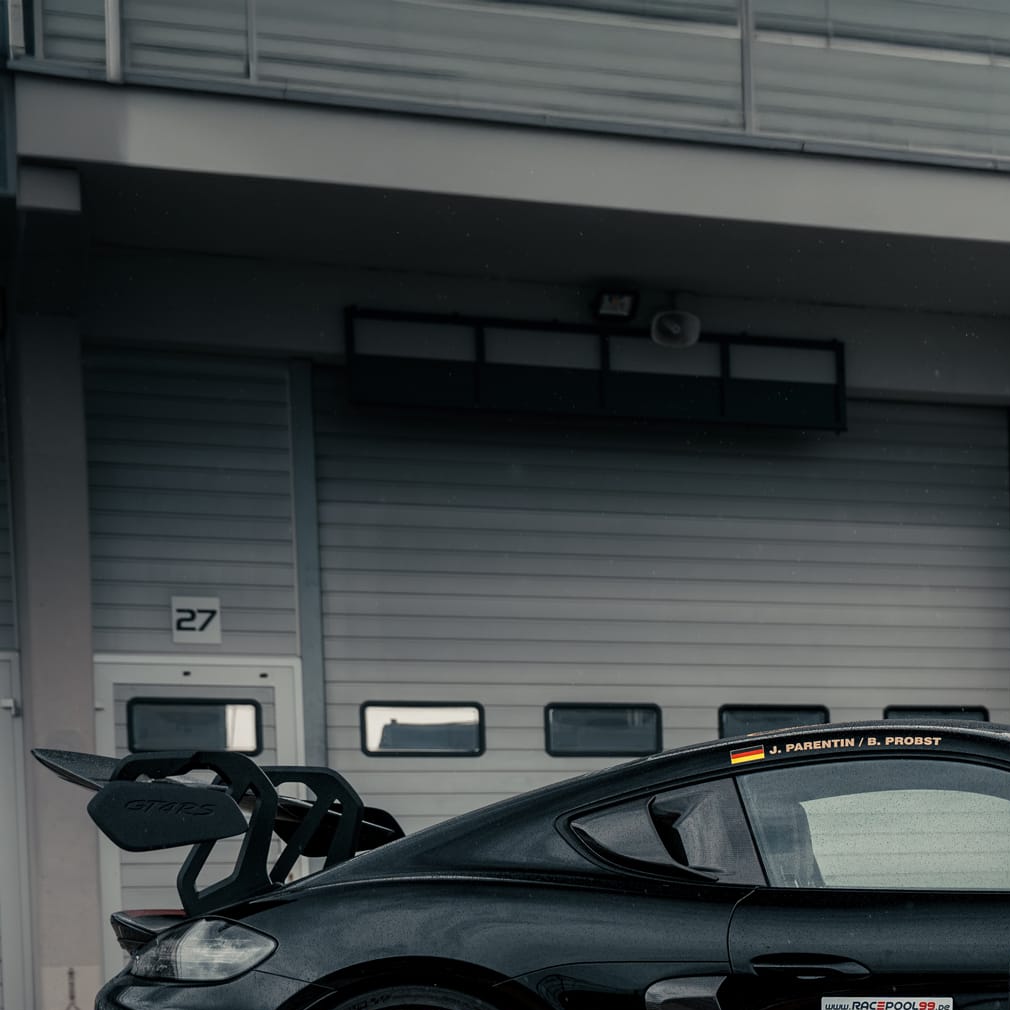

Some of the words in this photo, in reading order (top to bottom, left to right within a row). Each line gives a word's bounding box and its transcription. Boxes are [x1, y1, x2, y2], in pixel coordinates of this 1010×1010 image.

[176, 608, 217, 632] 27
[769, 745, 782, 755] J.
[785, 738, 855, 753] PARENTIN
[867, 736, 881, 746] B.
[885, 736, 942, 746] PROBST
